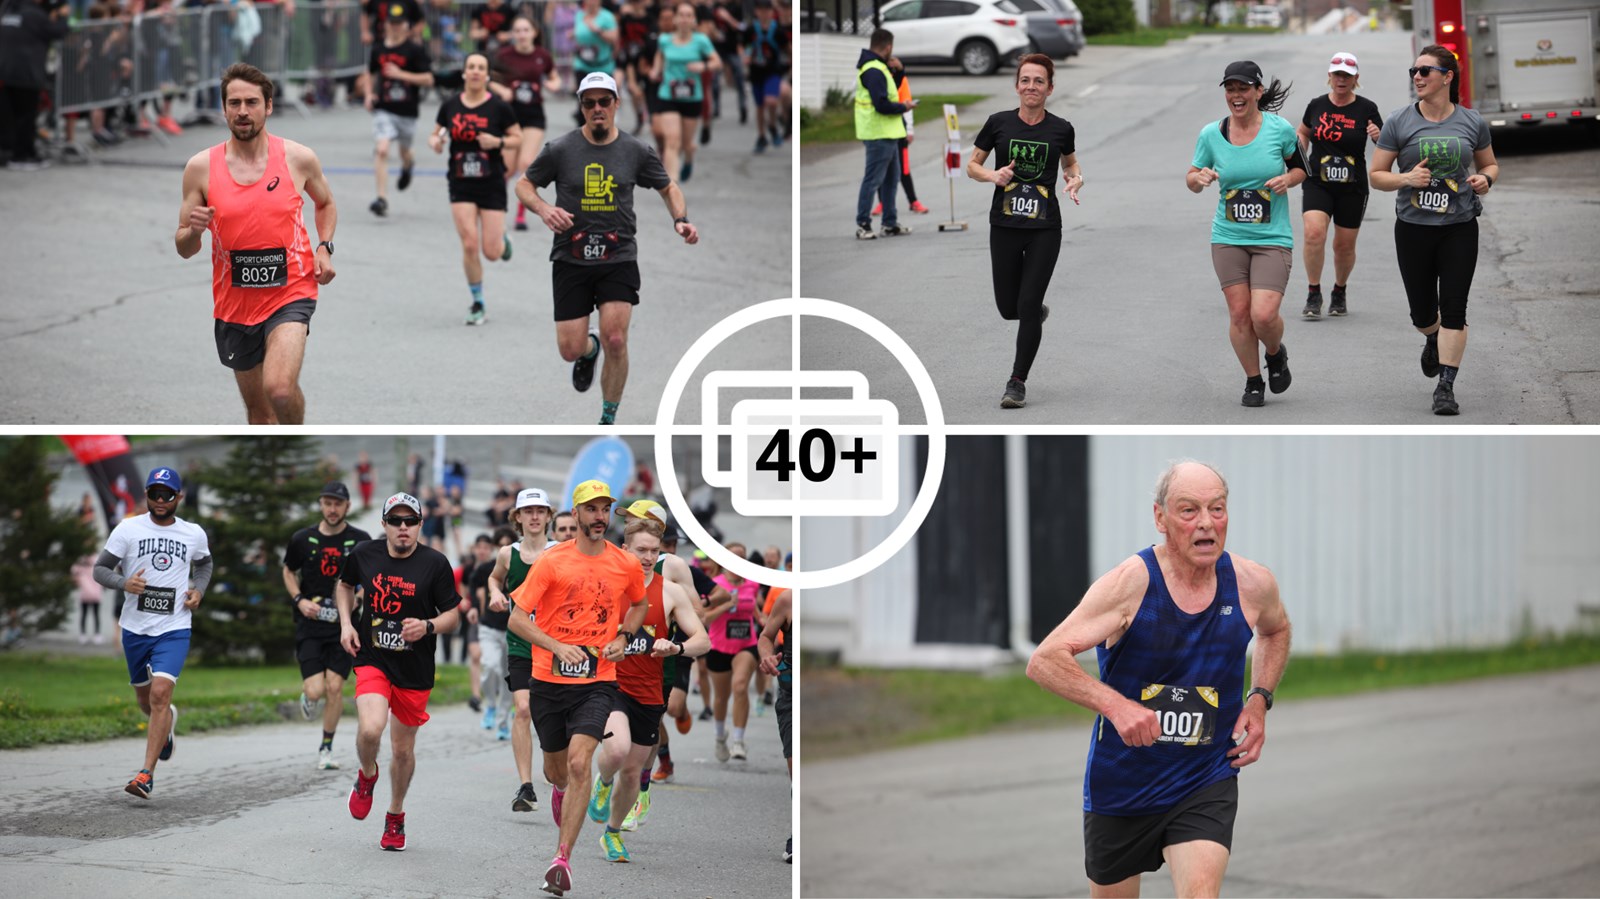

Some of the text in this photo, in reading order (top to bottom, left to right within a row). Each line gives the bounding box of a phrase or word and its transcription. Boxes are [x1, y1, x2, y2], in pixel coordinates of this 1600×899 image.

[1326, 166, 1348, 178] 1010
[1010, 196, 1039, 213] 1041
[1418, 191, 1449, 208] 1008
[1233, 203, 1263, 218] 1033
[584, 245, 606, 257] 647
[235, 254, 284, 264] SPORTCHRONO
[241, 266, 278, 282] 8037
[138, 538, 188, 563] HILFIGER
[144, 589, 174, 597] PORTCHRONO
[144, 597, 169, 610] 8032
[377, 631, 405, 647] 1023
